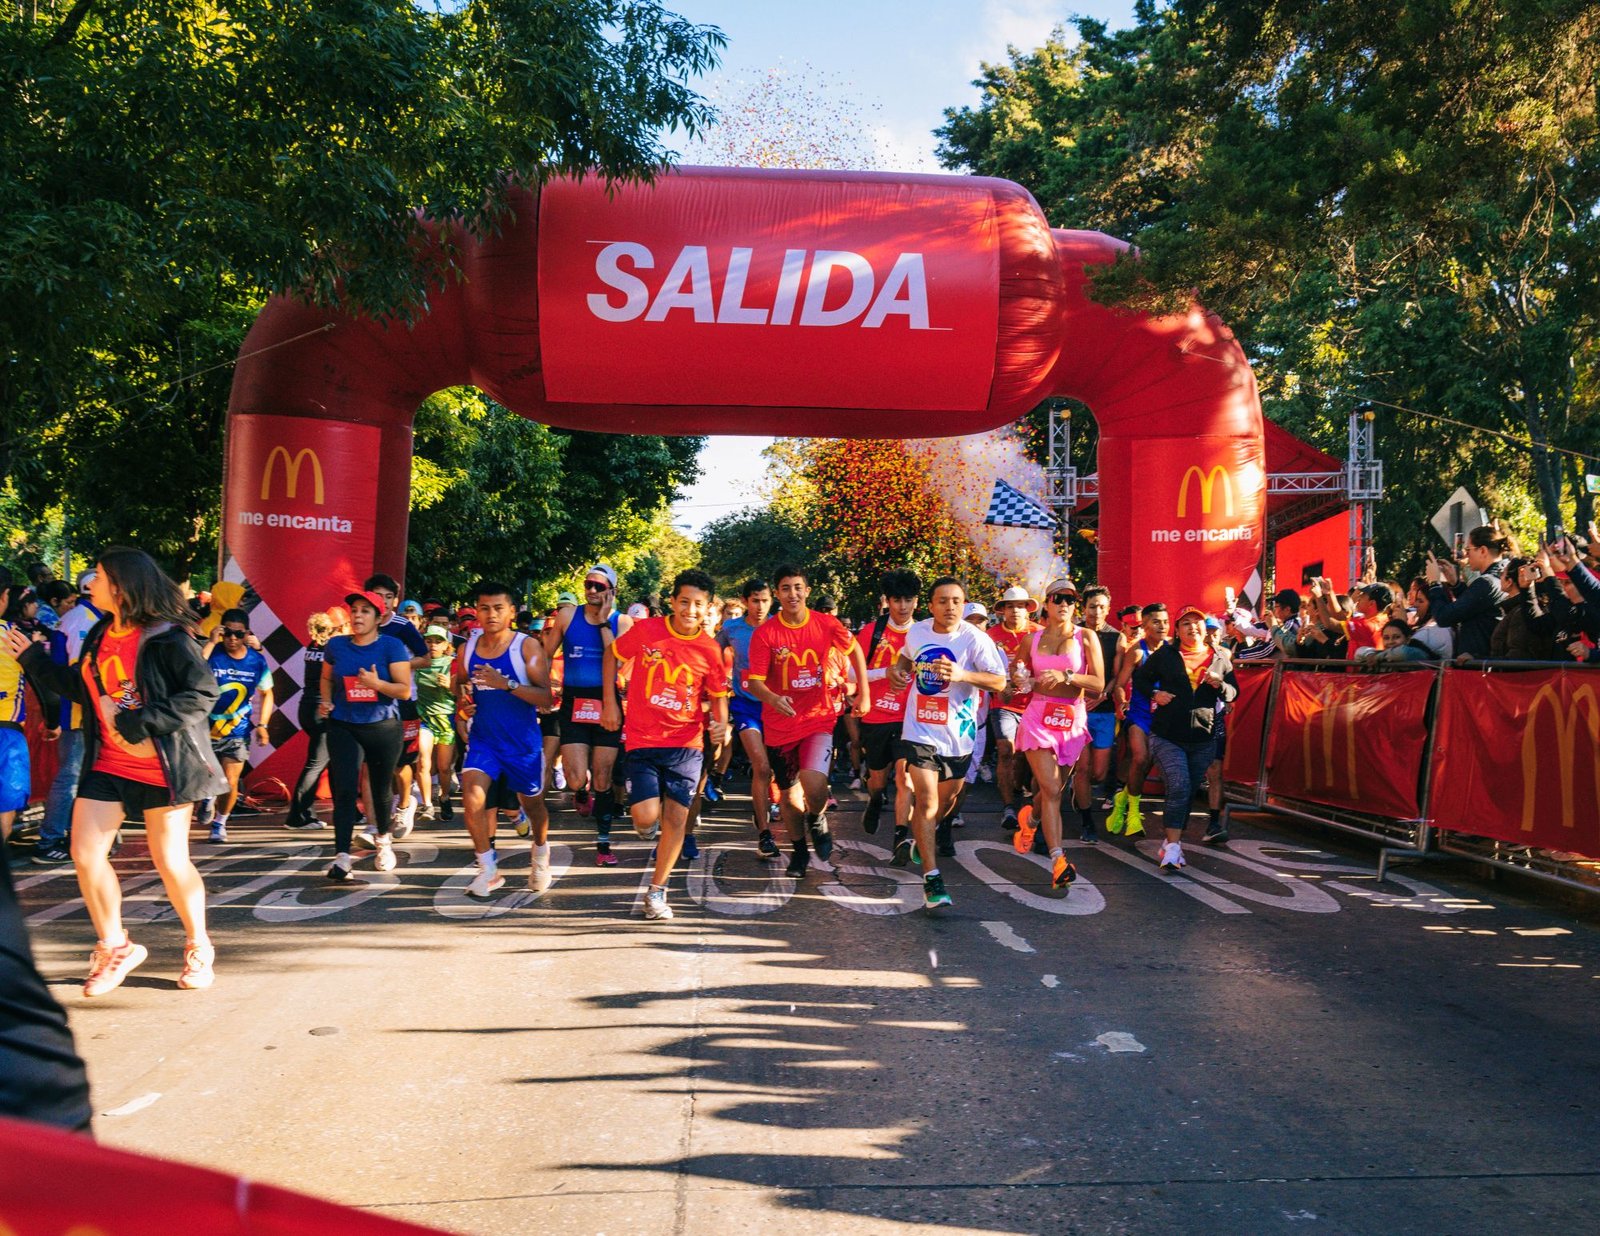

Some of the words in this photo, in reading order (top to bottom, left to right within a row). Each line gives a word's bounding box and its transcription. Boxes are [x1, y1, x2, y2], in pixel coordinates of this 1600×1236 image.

[586, 241, 931, 330] SALIDA
[238, 511, 264, 526] me
[266, 513, 353, 533] encanta
[1151, 529, 1181, 542] me
[1184, 525, 1252, 541] encanta
[650, 695, 682, 711] 0239
[875, 699, 900, 711] 2318
[918, 709, 947, 721] 5069
[1044, 715, 1072, 728] 0645
